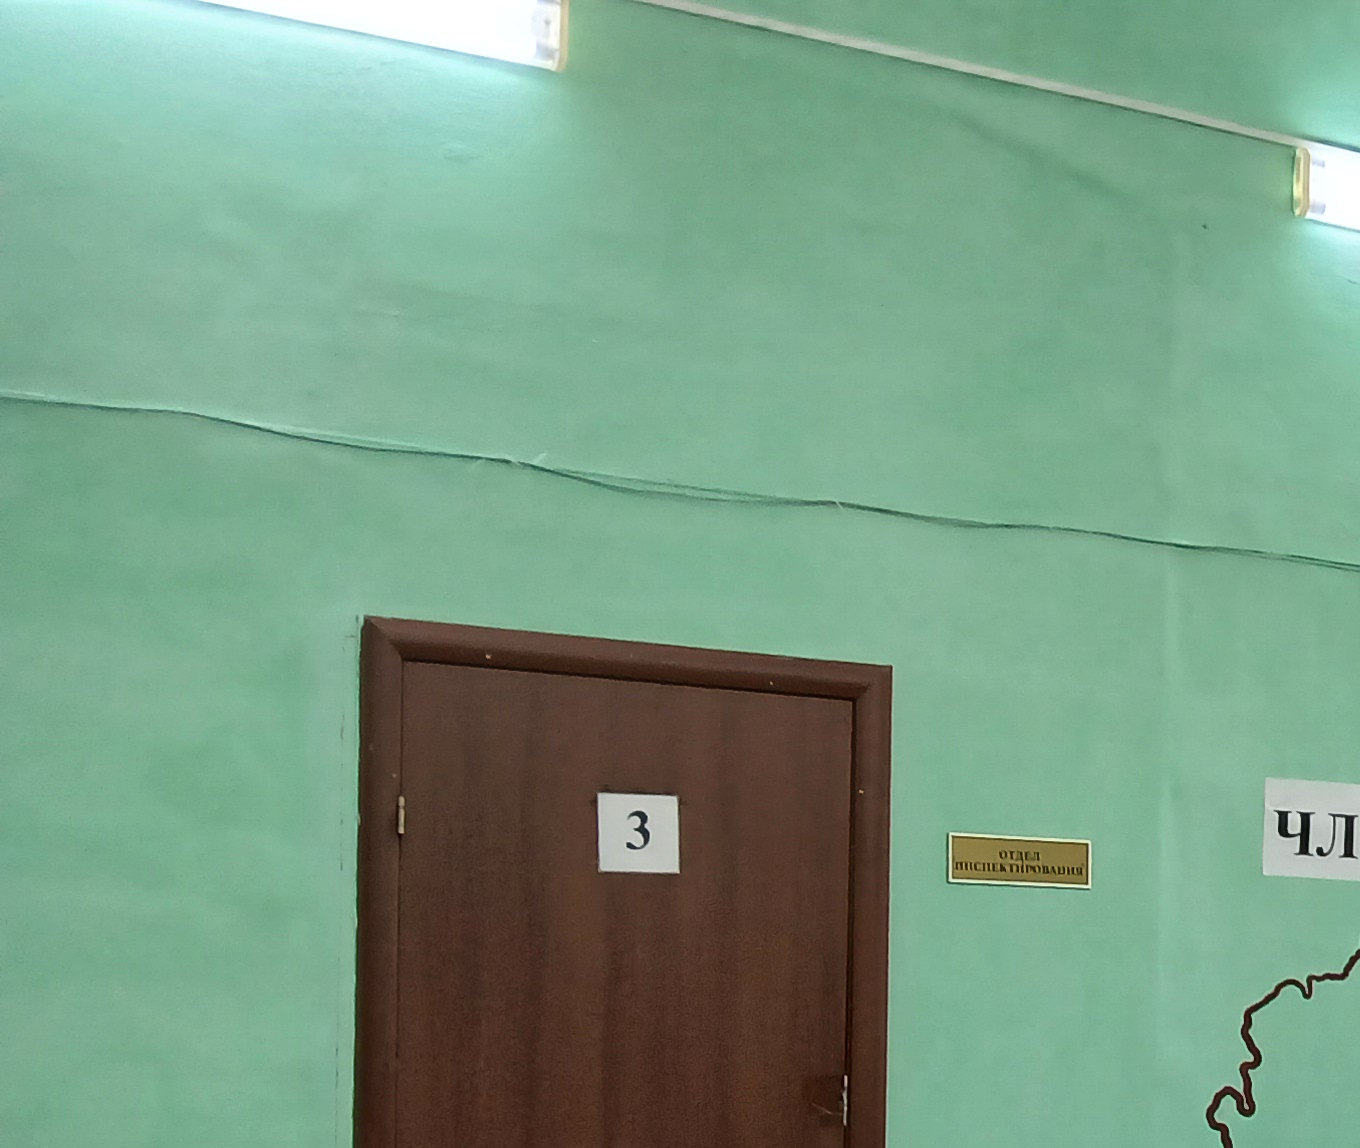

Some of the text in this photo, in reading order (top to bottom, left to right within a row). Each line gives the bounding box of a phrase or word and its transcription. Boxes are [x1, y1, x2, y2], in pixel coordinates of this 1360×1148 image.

[625, 809, 651, 851] 3
[998, 849, 1041, 864] ОТДЕЛ
[954, 860, 1084, 877] ИНСПЕКТИРОВАНИЯ
